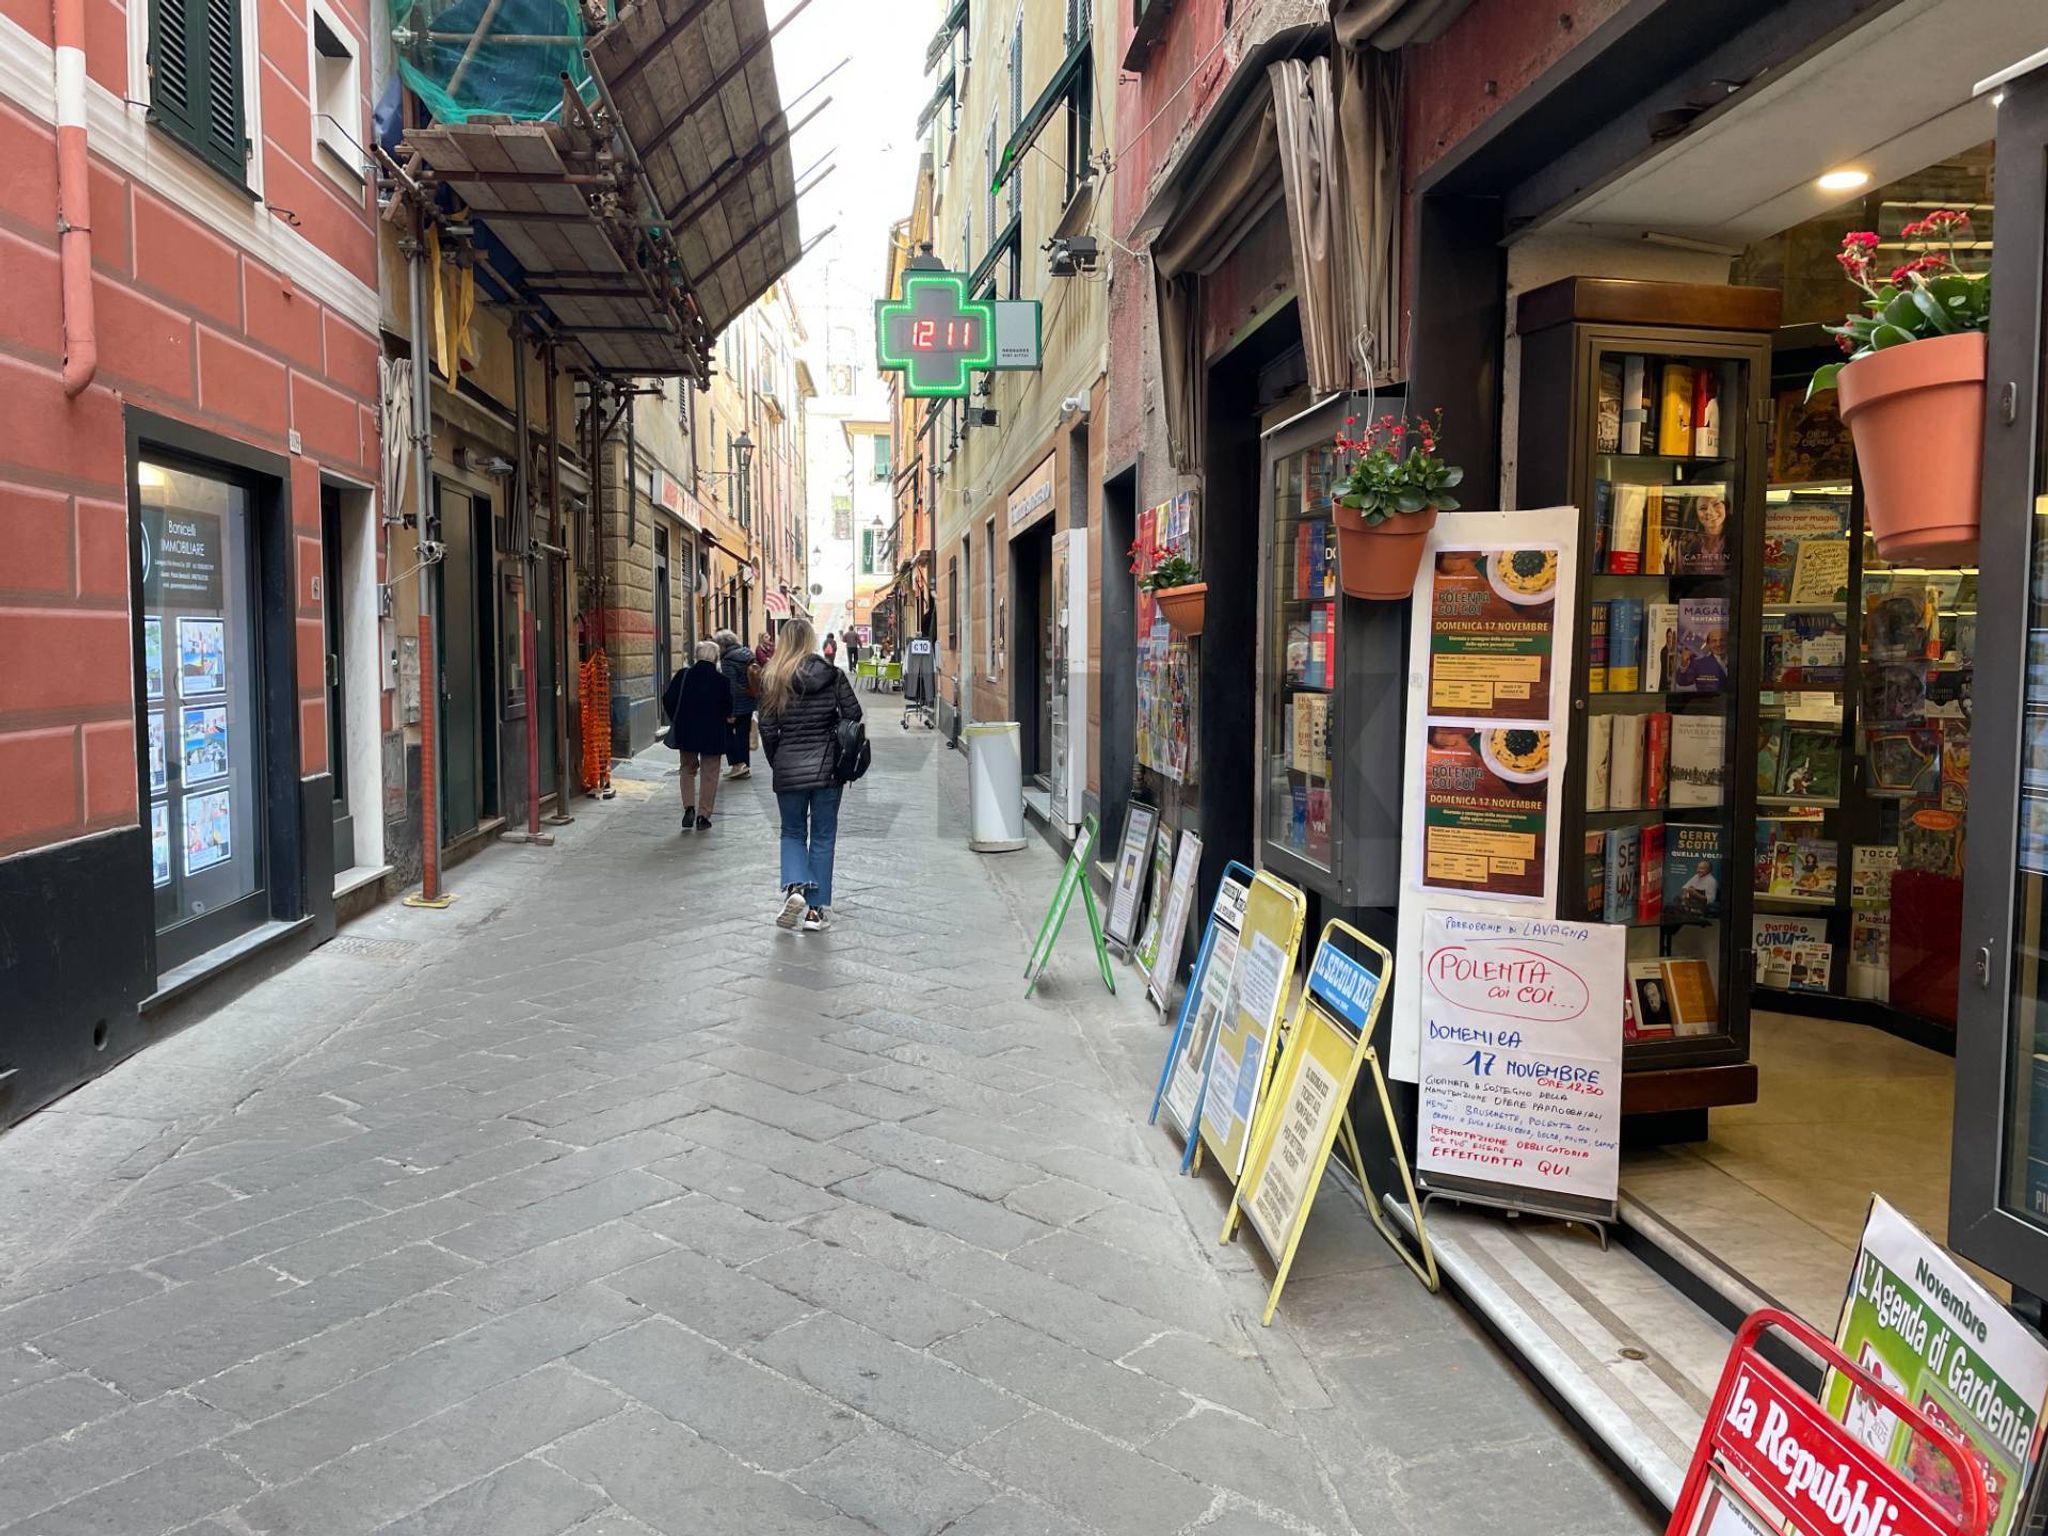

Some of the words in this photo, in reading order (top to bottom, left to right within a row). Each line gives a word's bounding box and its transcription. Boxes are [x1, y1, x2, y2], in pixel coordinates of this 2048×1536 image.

[161, 538, 205, 557] IMMOBILIARE
[1439, 591, 1490, 604] POLENTA
[1435, 621, 1483, 631] DOMENICA
[1485, 622, 1497, 632] 17
[1499, 622, 1549, 632] NOVEMBRE
[1432, 766, 1484, 780] POLENTA
[1430, 795, 1477, 806] DOMENICA
[1492, 798, 1542, 810] NOVEMBRE
[1680, 831, 1719, 841] GERRY
[1678, 840, 1719, 850] SCOTTI
[1671, 850, 1700, 858] QUELLA
[1523, 922, 1590, 941] LAVAGNA
[1440, 953, 1552, 985] POLENTA
[1315, 946, 1329, 977] IL
[1323, 952, 1358, 1001] SECOLO
[1353, 974, 1377, 1014] XIX
[1462, 1050, 1497, 1077] 17
[1507, 1060, 1600, 1085] NOVEMBRE
[1537, 1077, 1564, 1089] ORE
[1495, 1097, 1527, 1109] OPERE
[1540, 1091, 1568, 1101] DELLA
[1431, 1123, 1509, 1147] PRENOTAZIONE
[1516, 1140, 1590, 1158] OBBLIGATORIA
[1432, 1146, 1524, 1169] EFFETTUATA
[1537, 1159, 1571, 1177] QUI
[1915, 1257, 1987, 1344] Novembre
[1858, 1252, 1929, 1356] L'Agenda
[1927, 1326, 1950, 1376] di
[1947, 1346, 2030, 1464] Gardenia
[1726, 1376, 1758, 1438] la
[1755, 1399, 1904, 1536] Repubbli
